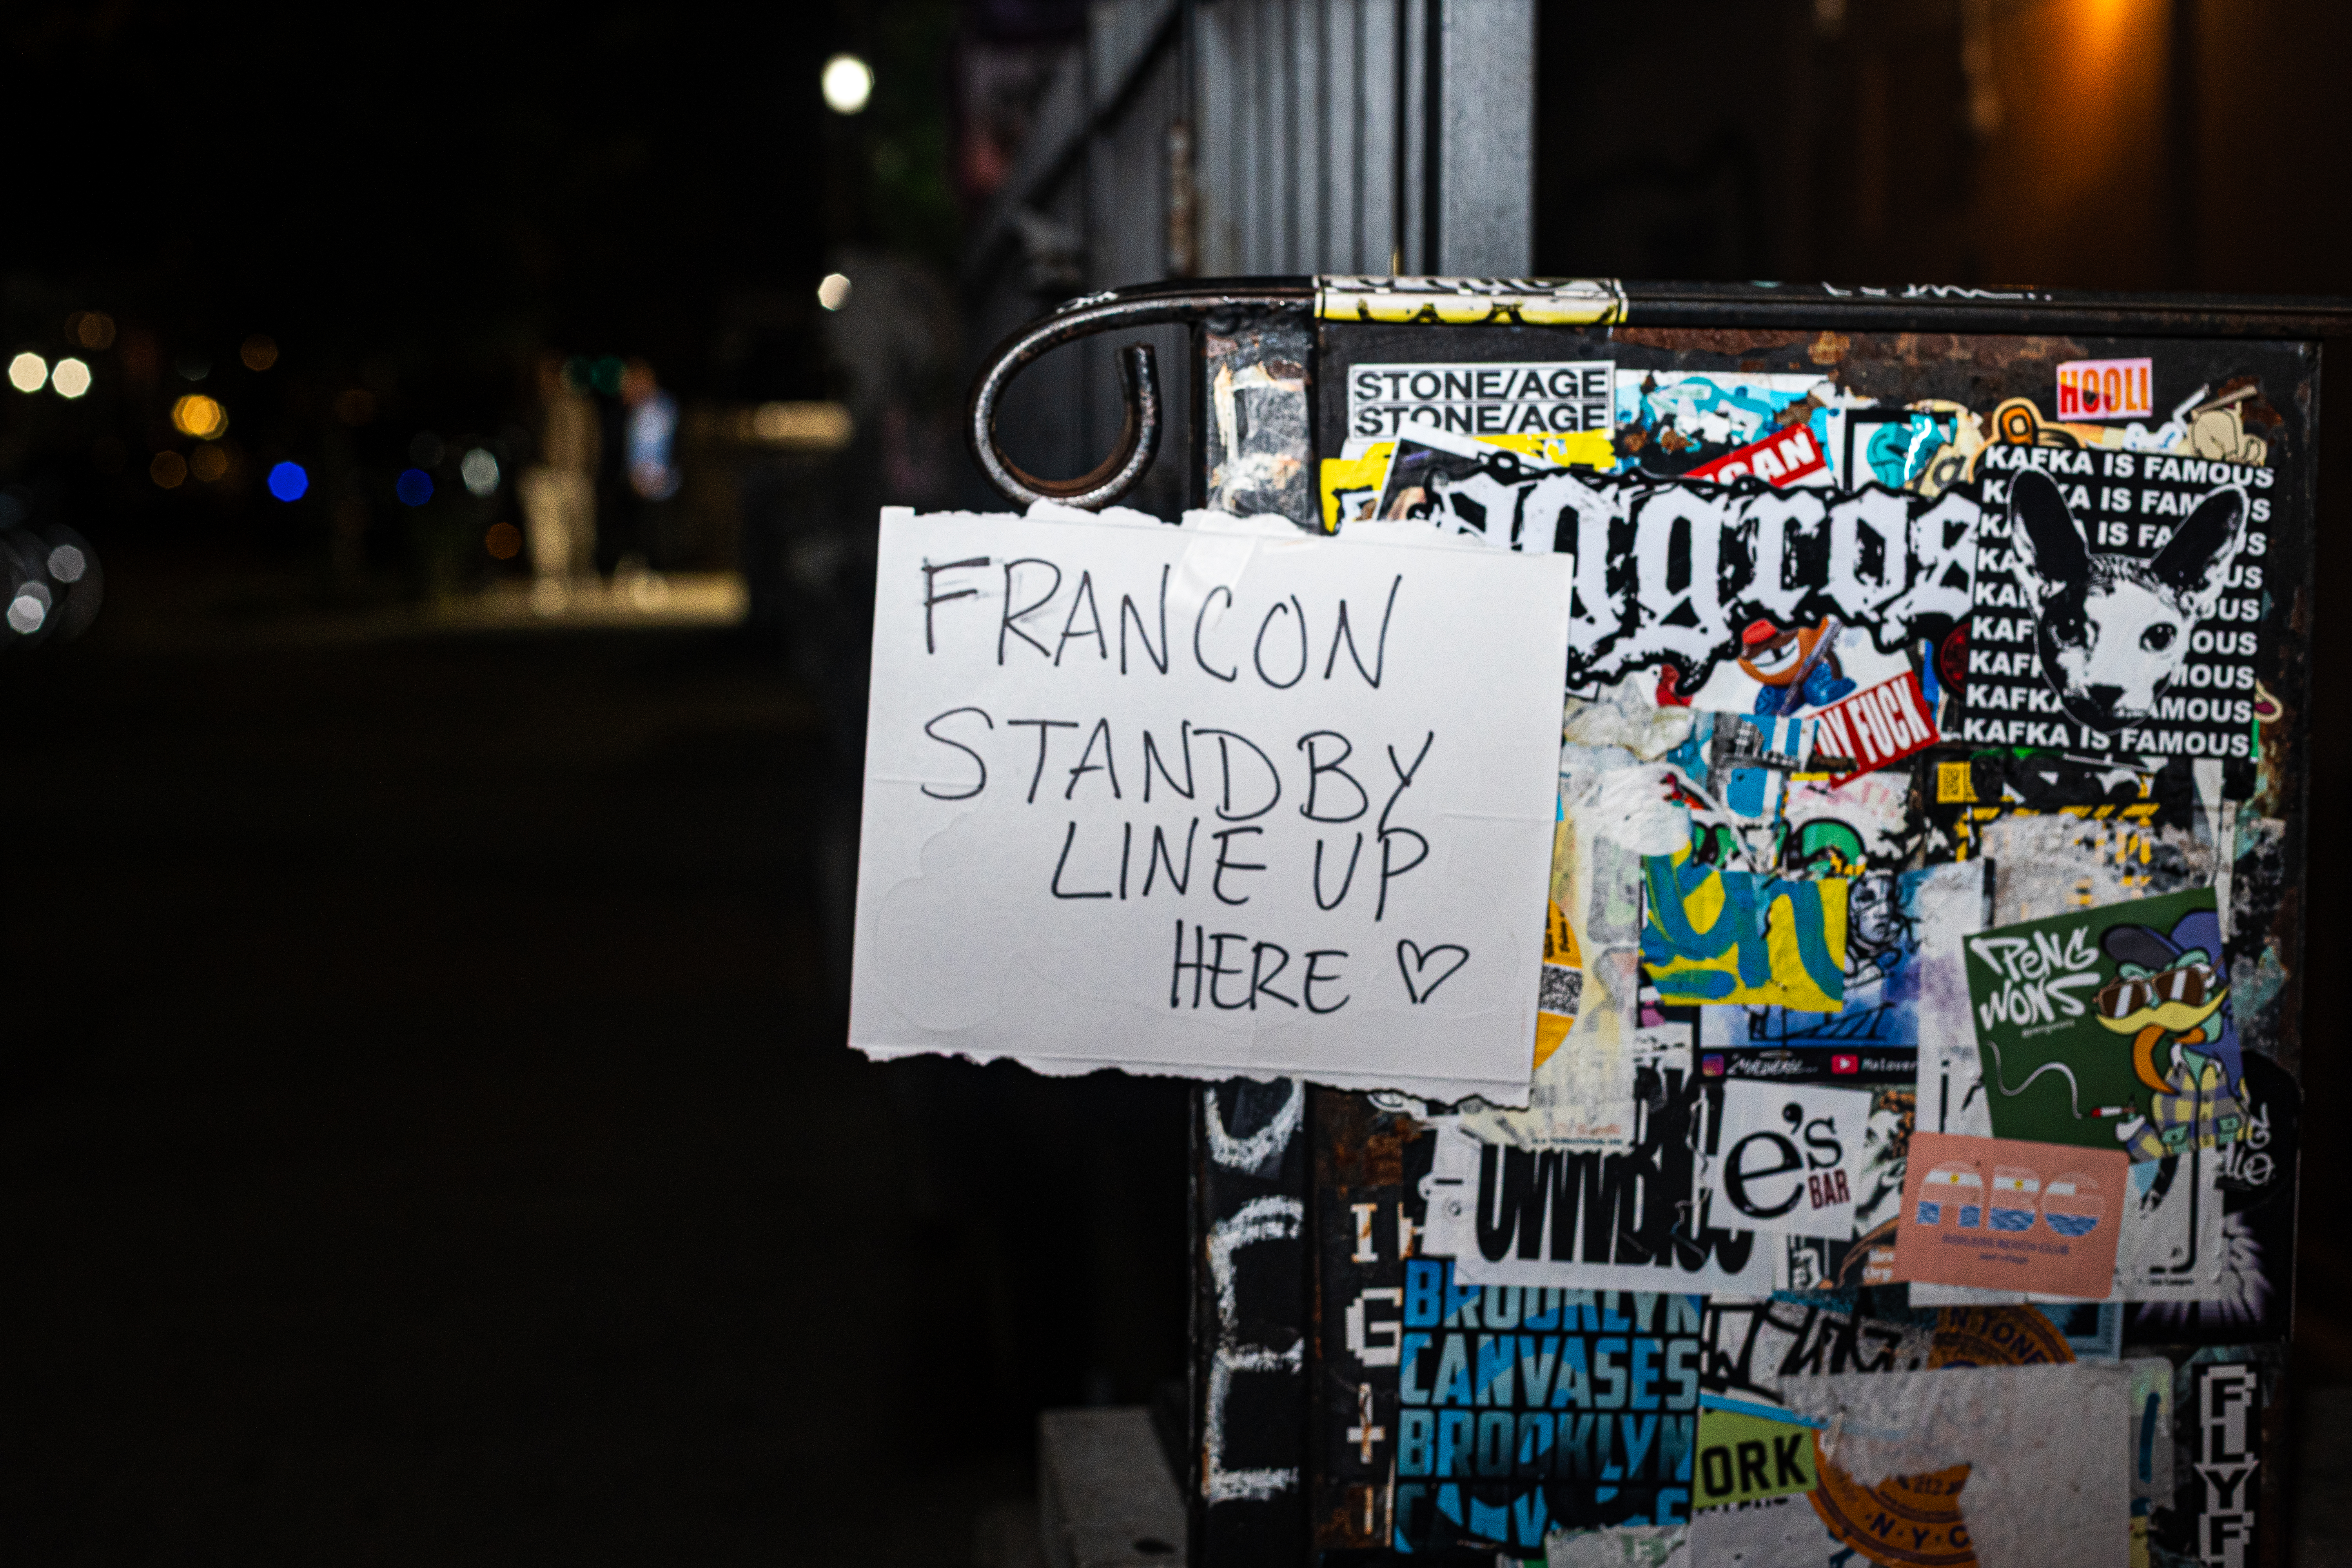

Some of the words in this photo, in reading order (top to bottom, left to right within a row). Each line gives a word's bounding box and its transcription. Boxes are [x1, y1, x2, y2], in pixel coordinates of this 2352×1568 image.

[1355, 370, 1606, 401] STONE/AGE
[2060, 367, 2149, 413] HOOLI
[1355, 404, 1606, 436] STONE/AGE
[1985, 445, 2094, 475] KAFKA
[2103, 453, 2135, 477] IS
[2143, 456, 2274, 489] FAMOUS
[2097, 521, 2129, 546] IS
[2100, 486, 2132, 512] IS
[2140, 488, 2272, 523] FAMS
[921, 556, 1401, 689] FRANCON
[1971, 615, 2036, 643] KAF
[1846, 675, 1932, 764] FUCK
[1963, 717, 2071, 748] KAFKA
[2080, 725, 2111, 750] IS
[2120, 727, 2250, 757] FAMOUS
[921, 706, 1434, 833] STANDBY
[1051, 817, 1267, 906] LINE
[1314, 828, 1429, 921] UP
[1171, 918, 1351, 1014] HERE
[1723, 1101, 1842, 1220] e's
[1809, 1168, 1850, 1210] BAR
[1403, 1259, 1702, 1334] BROOKLYN
[1399, 1332, 1700, 1410] CANVASES
[1397, 1410, 1695, 1483] BROOKLYN
[1700, 1433, 1806, 1497] ORK
